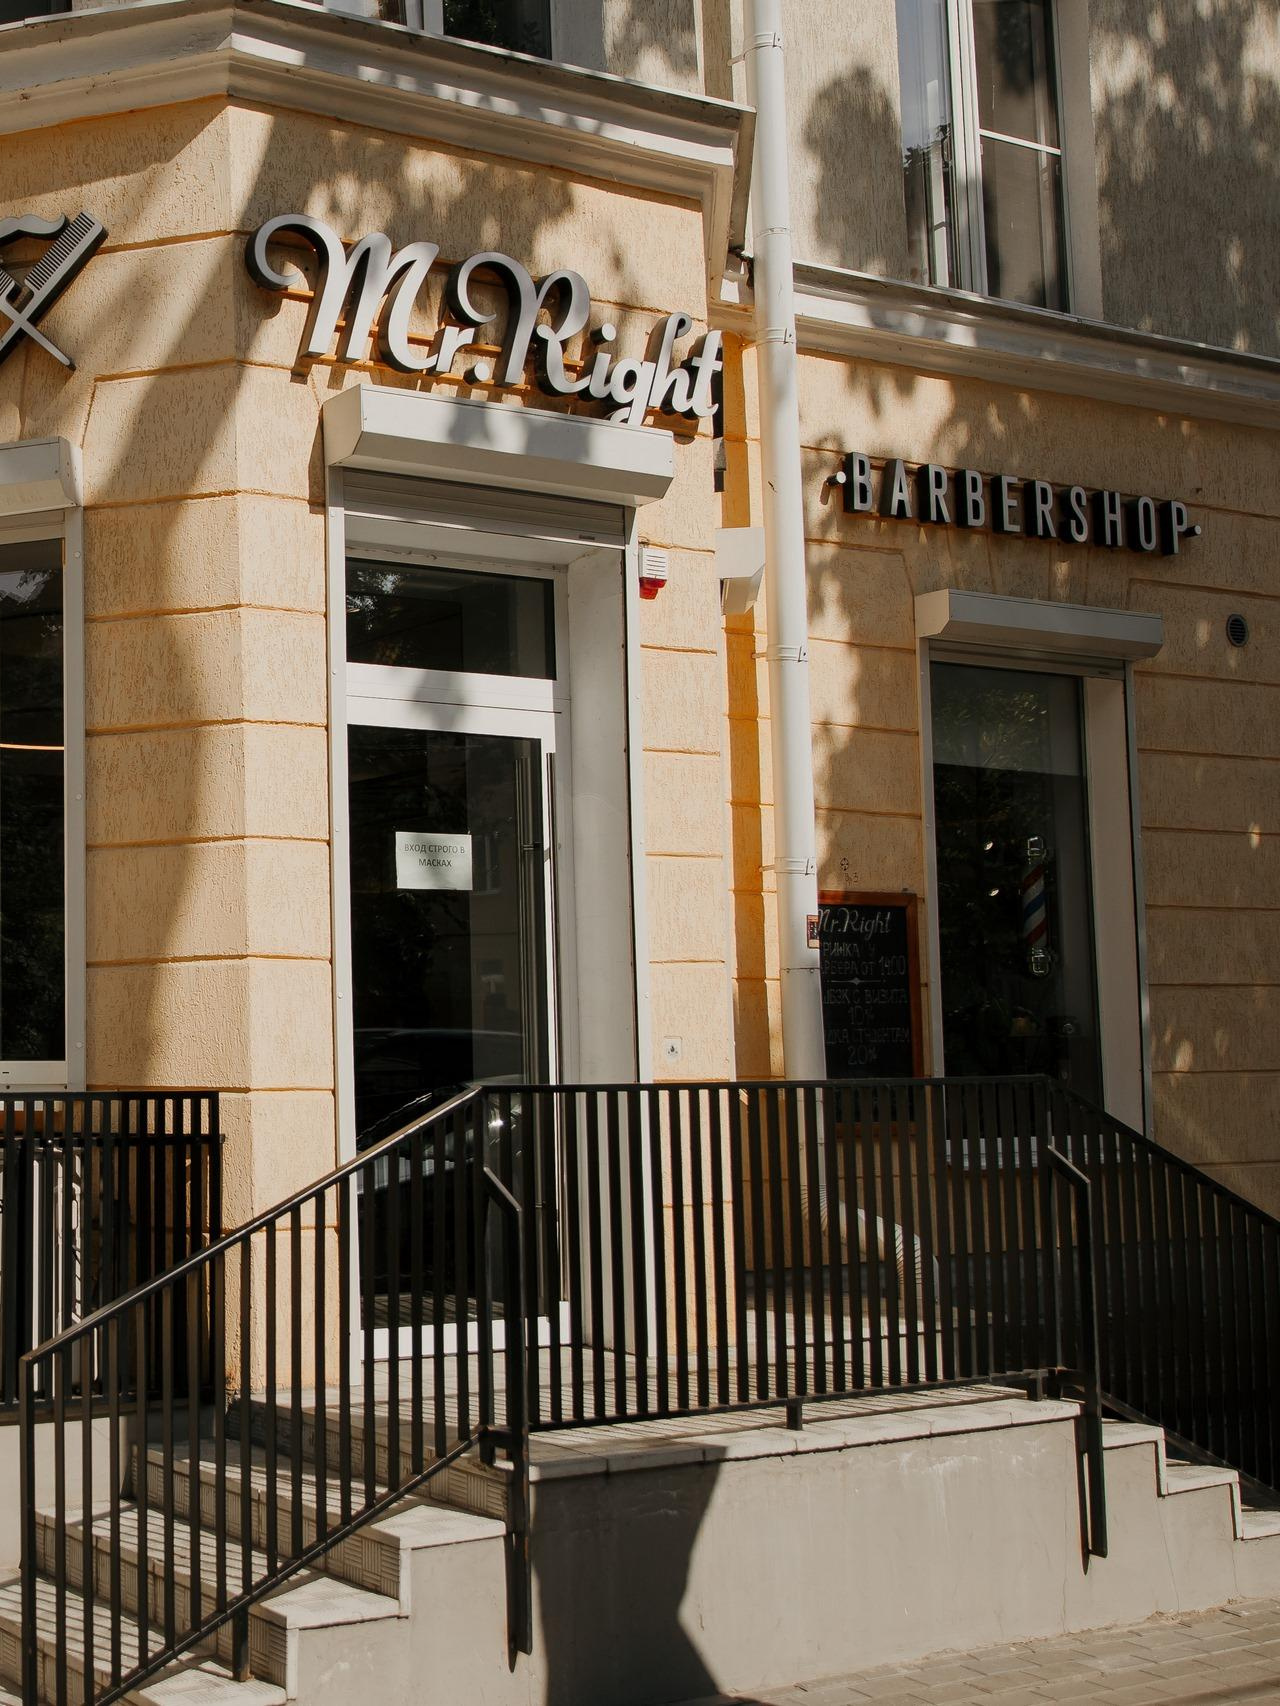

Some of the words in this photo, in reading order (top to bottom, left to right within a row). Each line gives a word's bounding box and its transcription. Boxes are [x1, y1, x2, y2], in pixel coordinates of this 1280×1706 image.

[843, 451, 1190, 556] BARBERSHOP
[404, 843, 427, 854] ВХОД
[428, 844, 458, 854] СТРОГО
[418, 858, 452, 867] МАСКАХ
